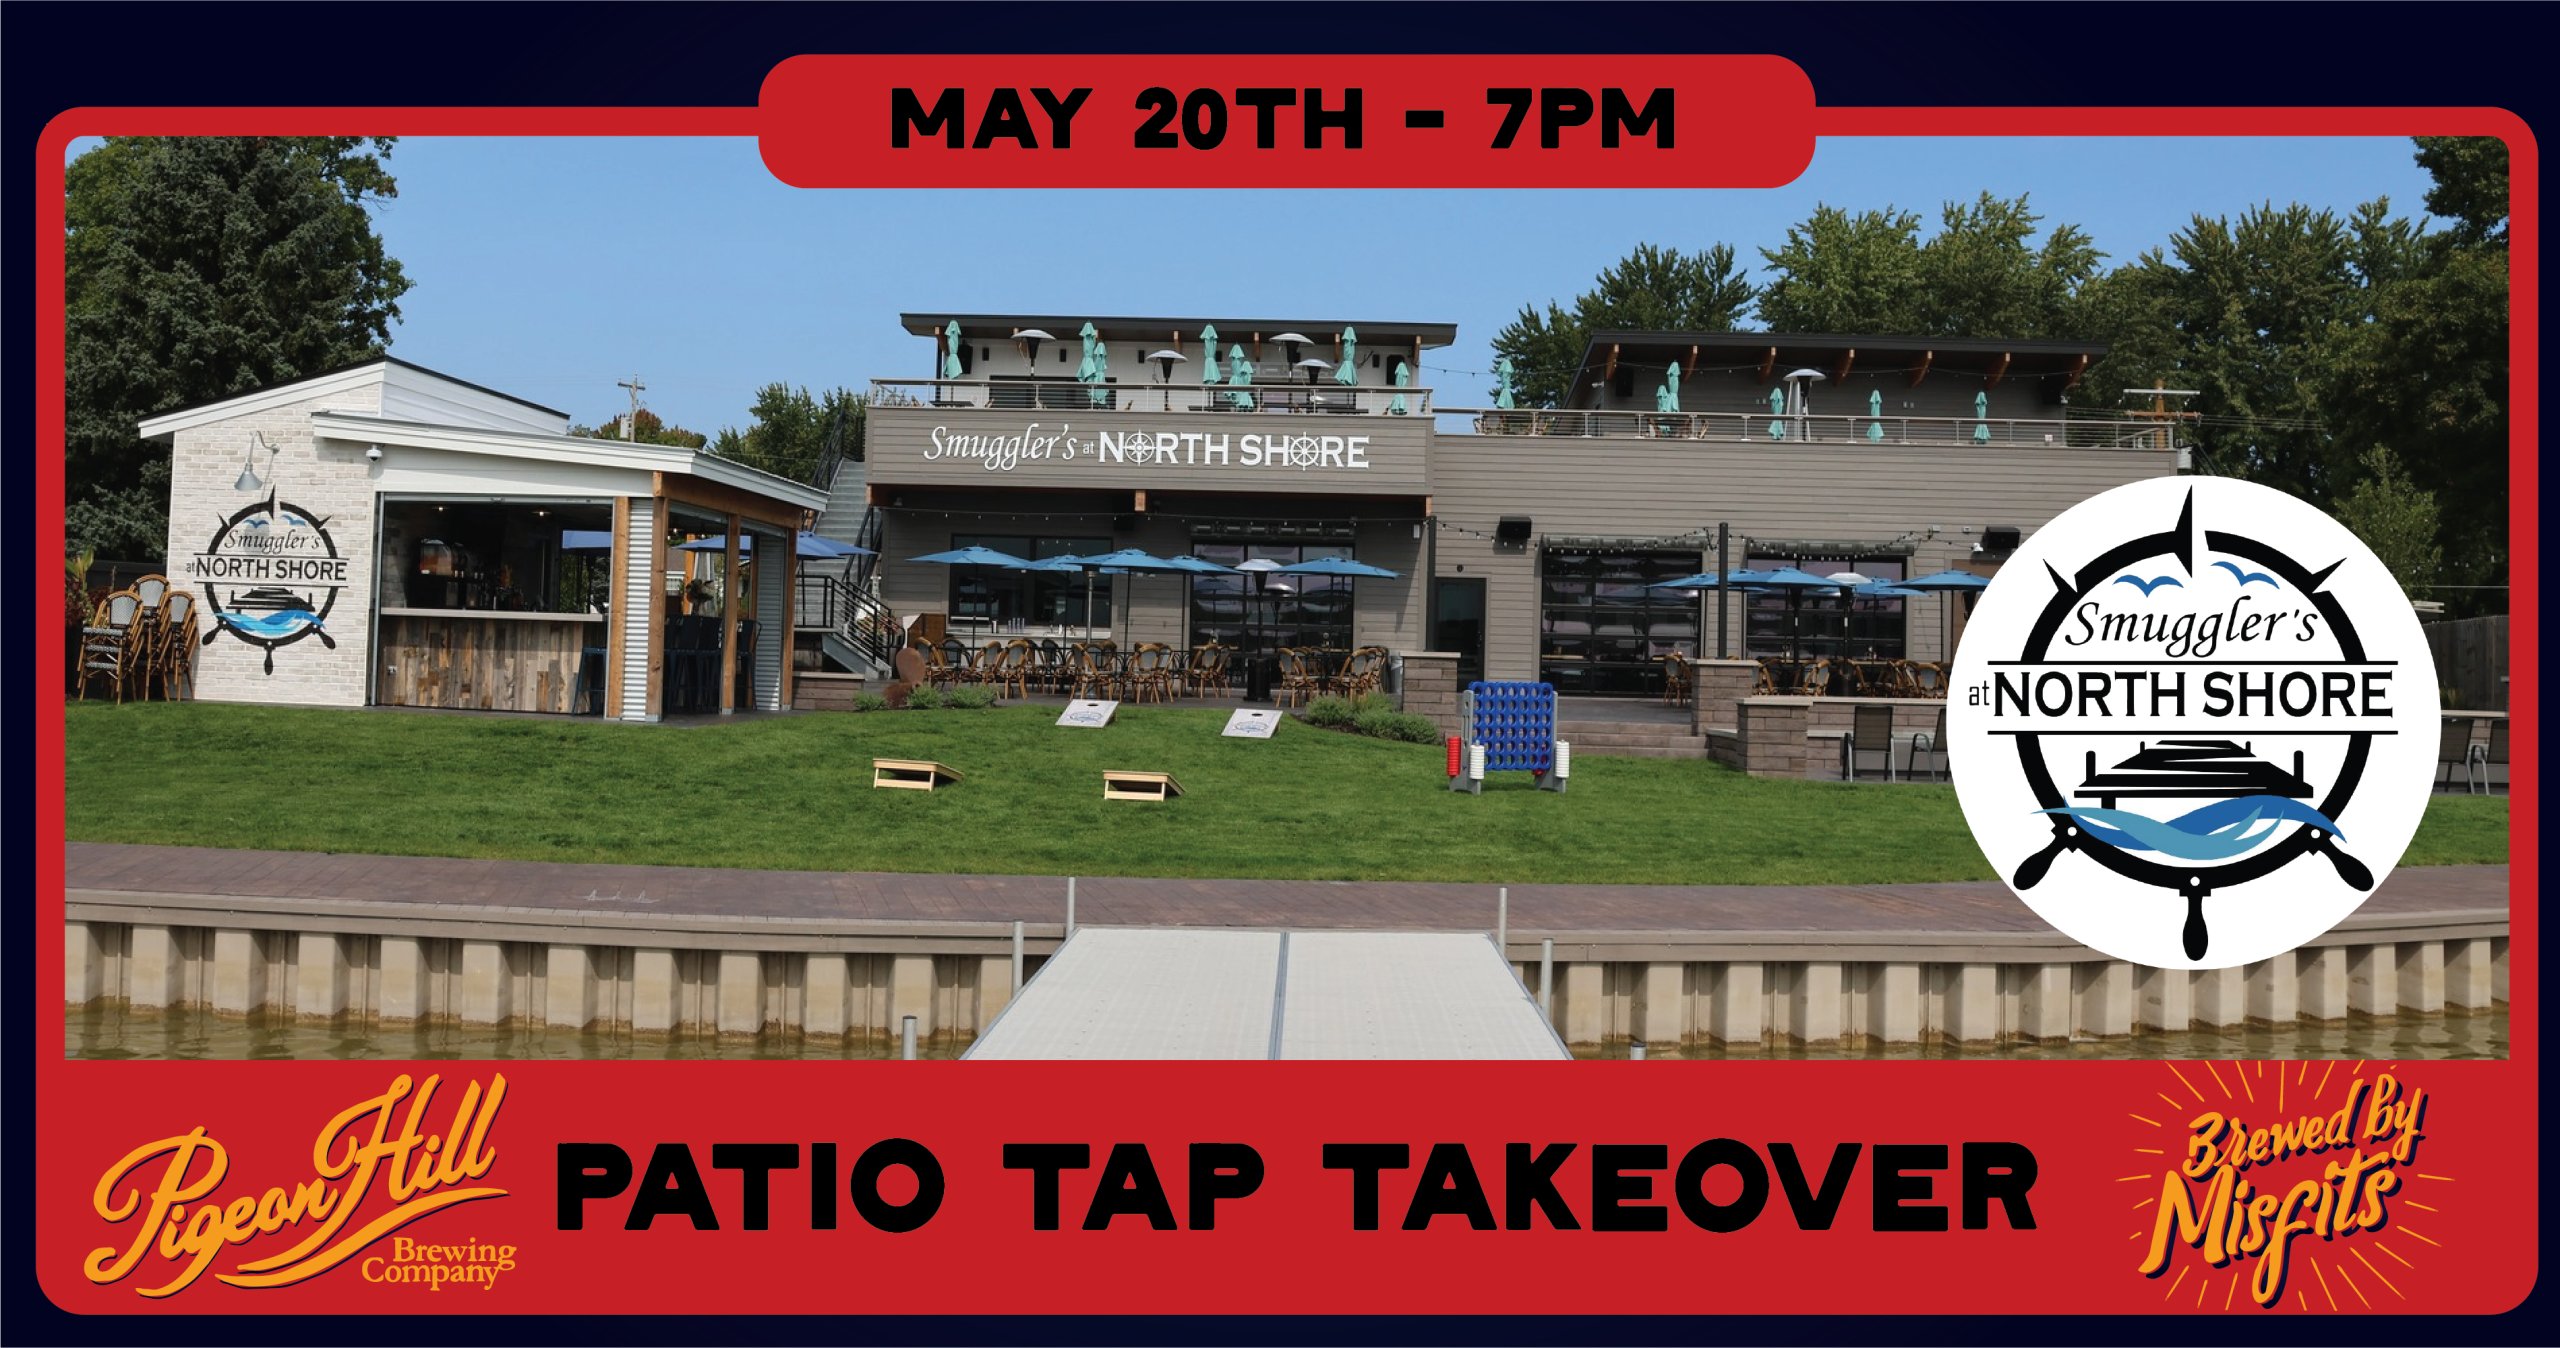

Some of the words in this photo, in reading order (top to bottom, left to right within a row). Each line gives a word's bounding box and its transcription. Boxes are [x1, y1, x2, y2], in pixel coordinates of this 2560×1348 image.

[923, 422, 1078, 471] Smuggler's
[1082, 441, 1095, 455] at
[1098, 429, 1229, 467] NORTH
[1239, 431, 1370, 471] SHORE
[224, 529, 321, 555] Smuggler's
[186, 561, 195, 573] at
[196, 557, 270, 579] NORTH
[275, 559, 348, 581] SHORE
